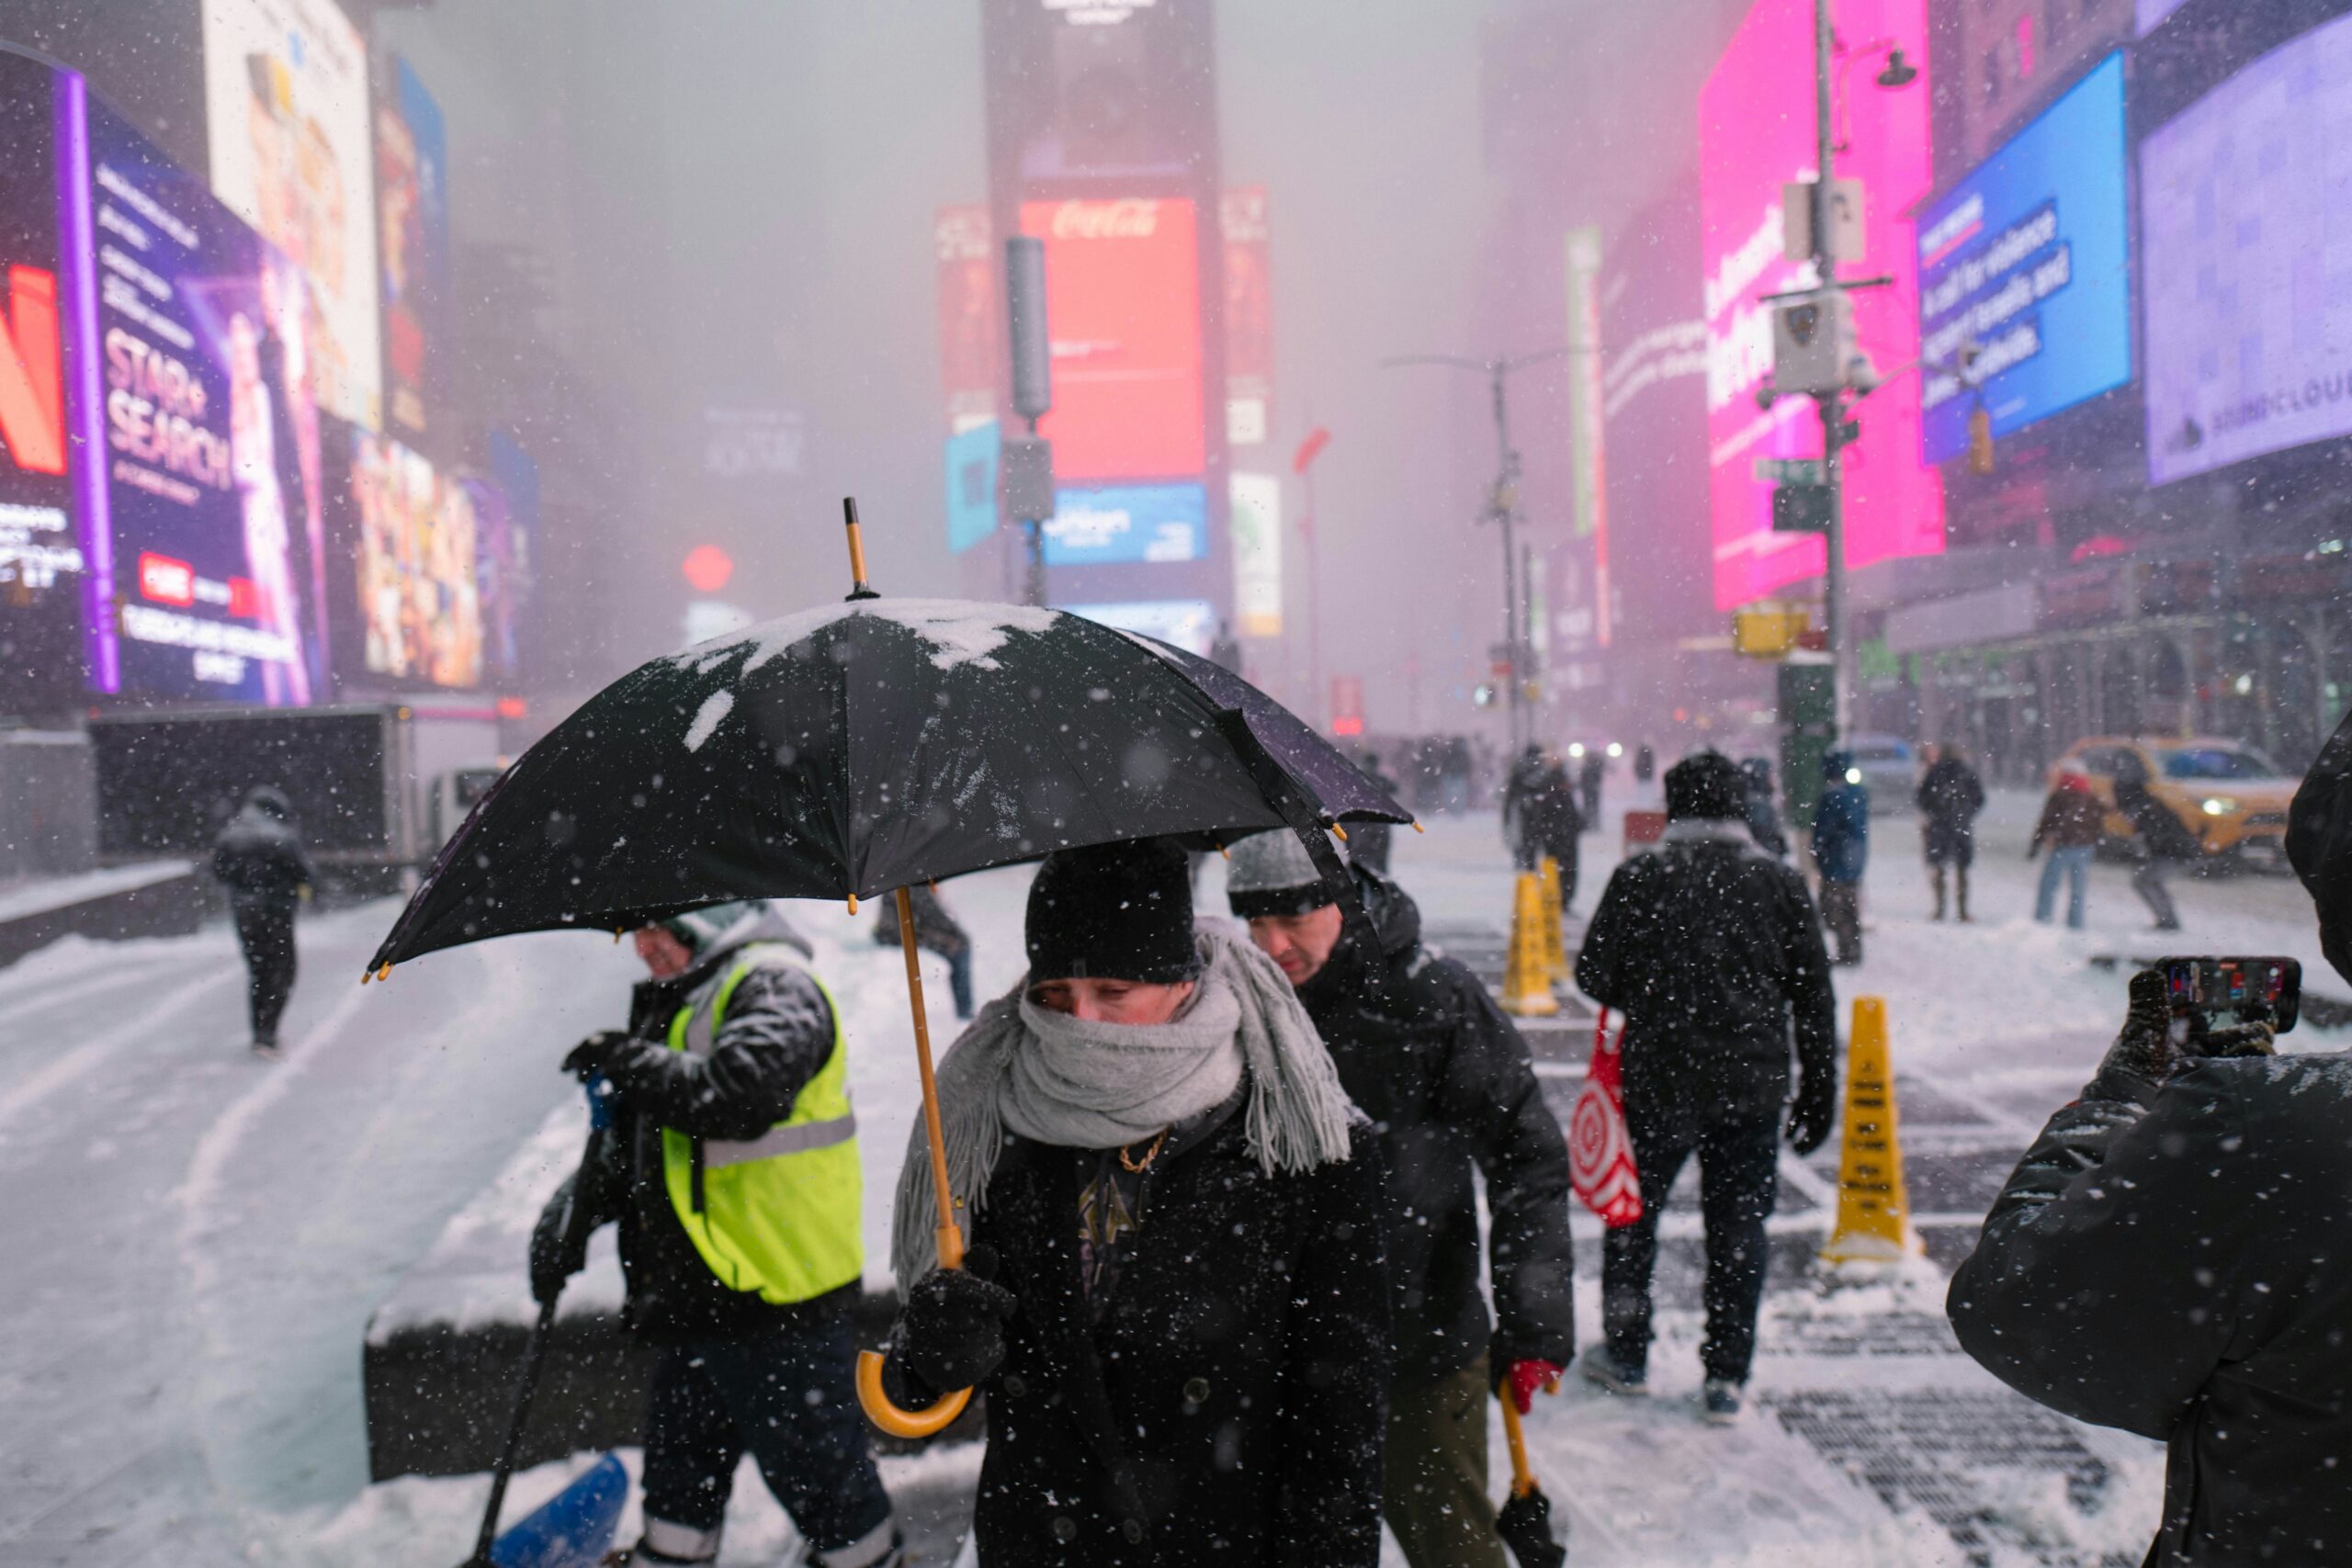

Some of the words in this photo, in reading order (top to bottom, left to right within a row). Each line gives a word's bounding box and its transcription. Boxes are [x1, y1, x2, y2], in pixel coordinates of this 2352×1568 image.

[106, 327, 196, 418] STAR
[2207, 368, 2352, 439] SOUNDCLOU
[107, 388, 232, 491] SEARCH
